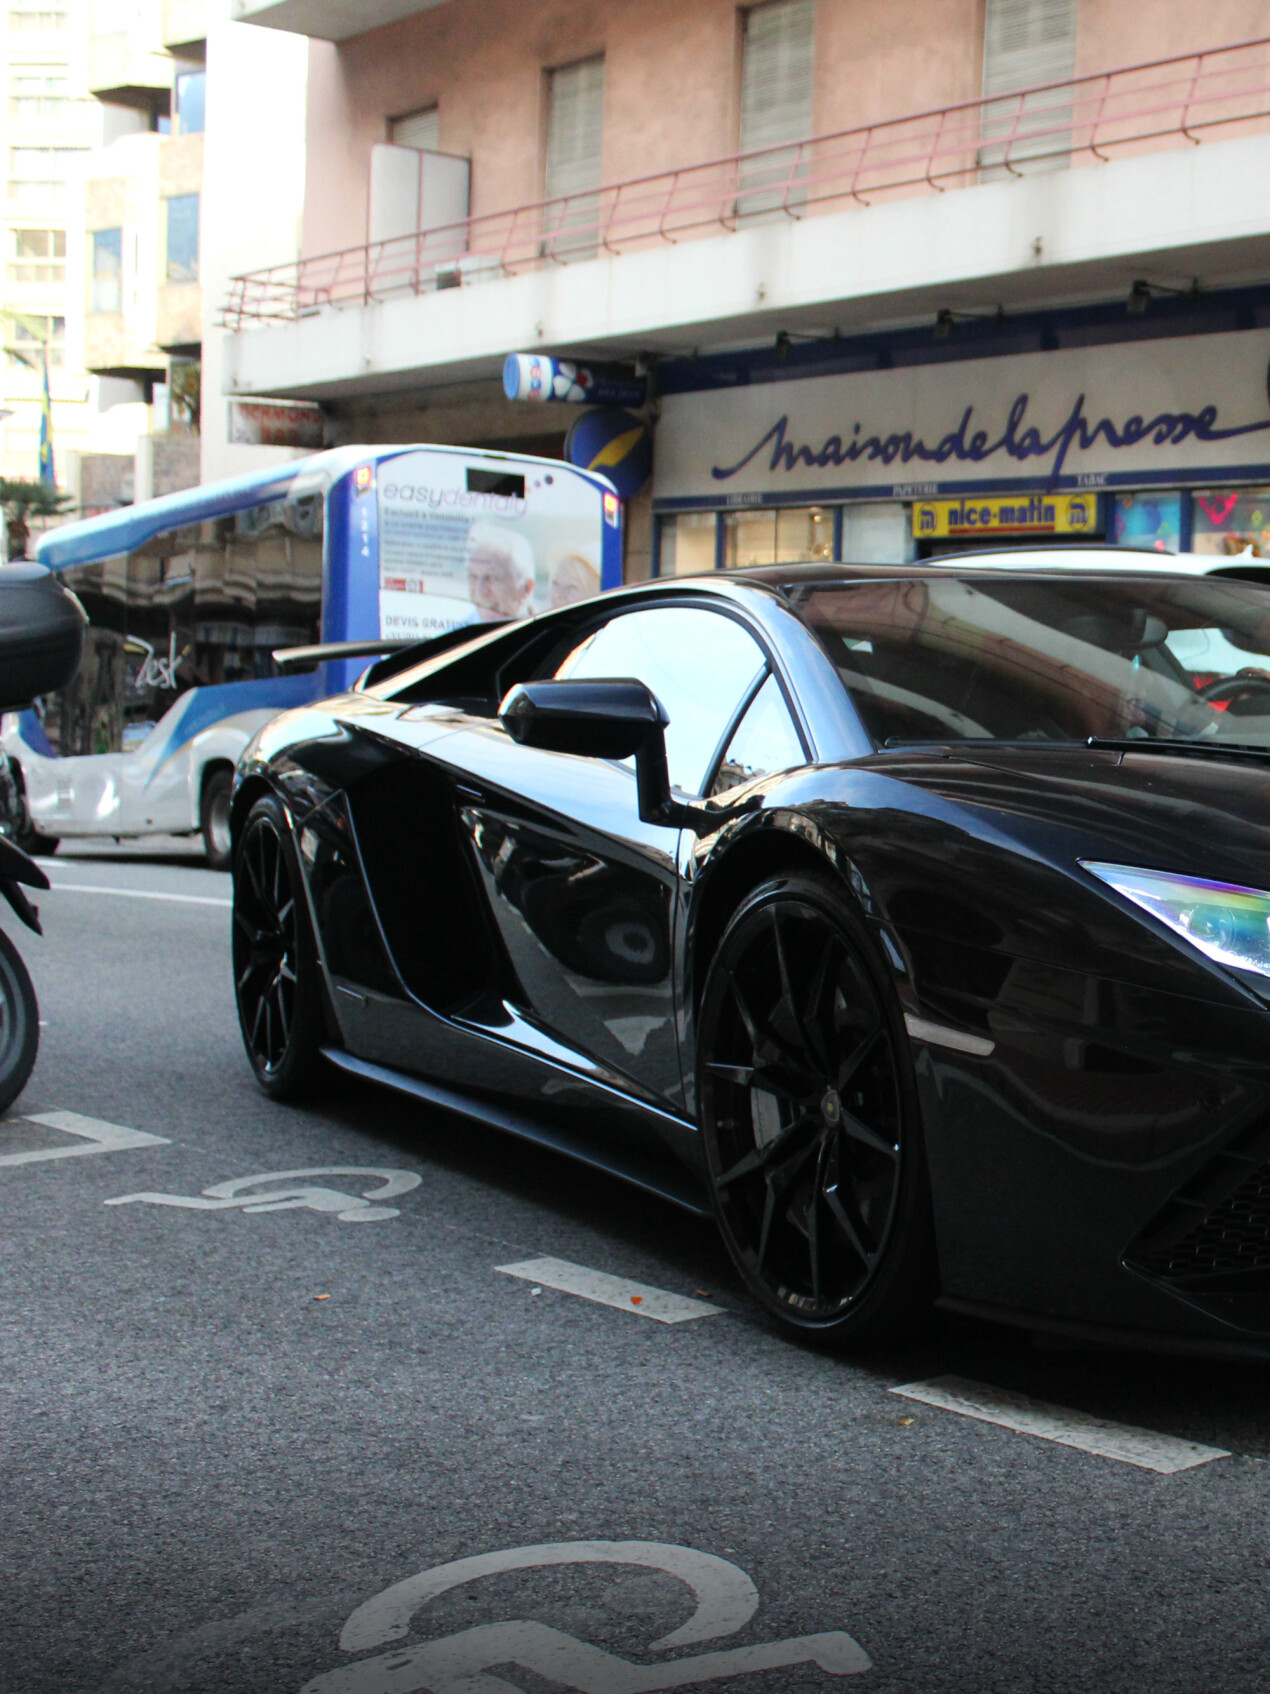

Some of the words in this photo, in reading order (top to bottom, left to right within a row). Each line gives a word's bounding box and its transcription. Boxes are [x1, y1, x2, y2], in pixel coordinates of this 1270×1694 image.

[1076, 473, 1108, 486] TABAC
[892, 483, 939, 497] PAPETERIE
[726, 493, 763, 506] LIBRAIRIE
[948, 497, 1056, 526] nice-matin
[385, 615, 419, 627] DEVIS
